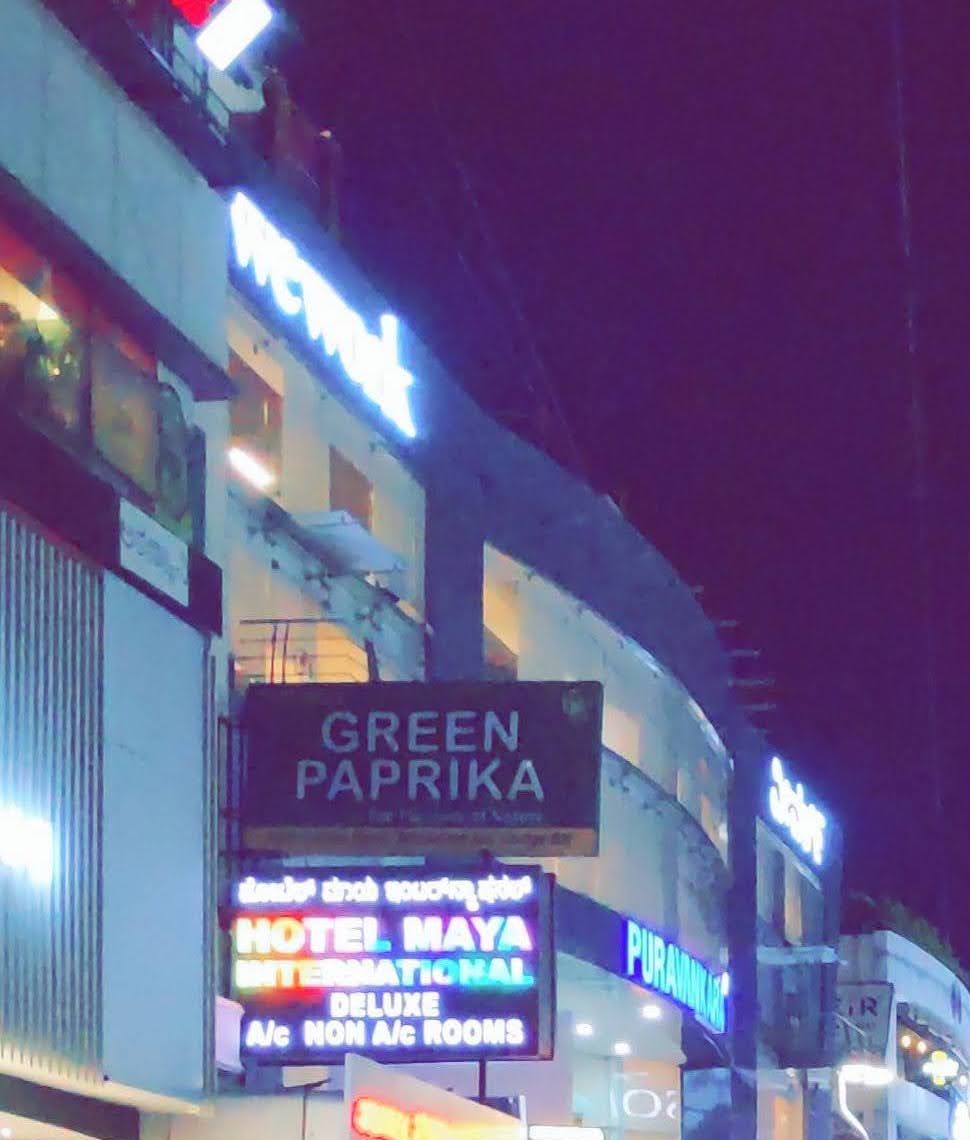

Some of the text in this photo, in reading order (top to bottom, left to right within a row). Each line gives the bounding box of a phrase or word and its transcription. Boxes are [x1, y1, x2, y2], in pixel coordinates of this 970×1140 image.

[320, 710, 520, 754] GREEN
[296, 759, 545, 801] PAPRIKA
[235, 916, 533, 953] HOTEL MAYA
[235, 958, 534, 987] INTERNATIONAL
[330, 992, 440, 1018] DELUXE
[246, 1019, 524, 1046] A/c NON A/c ROOMS
